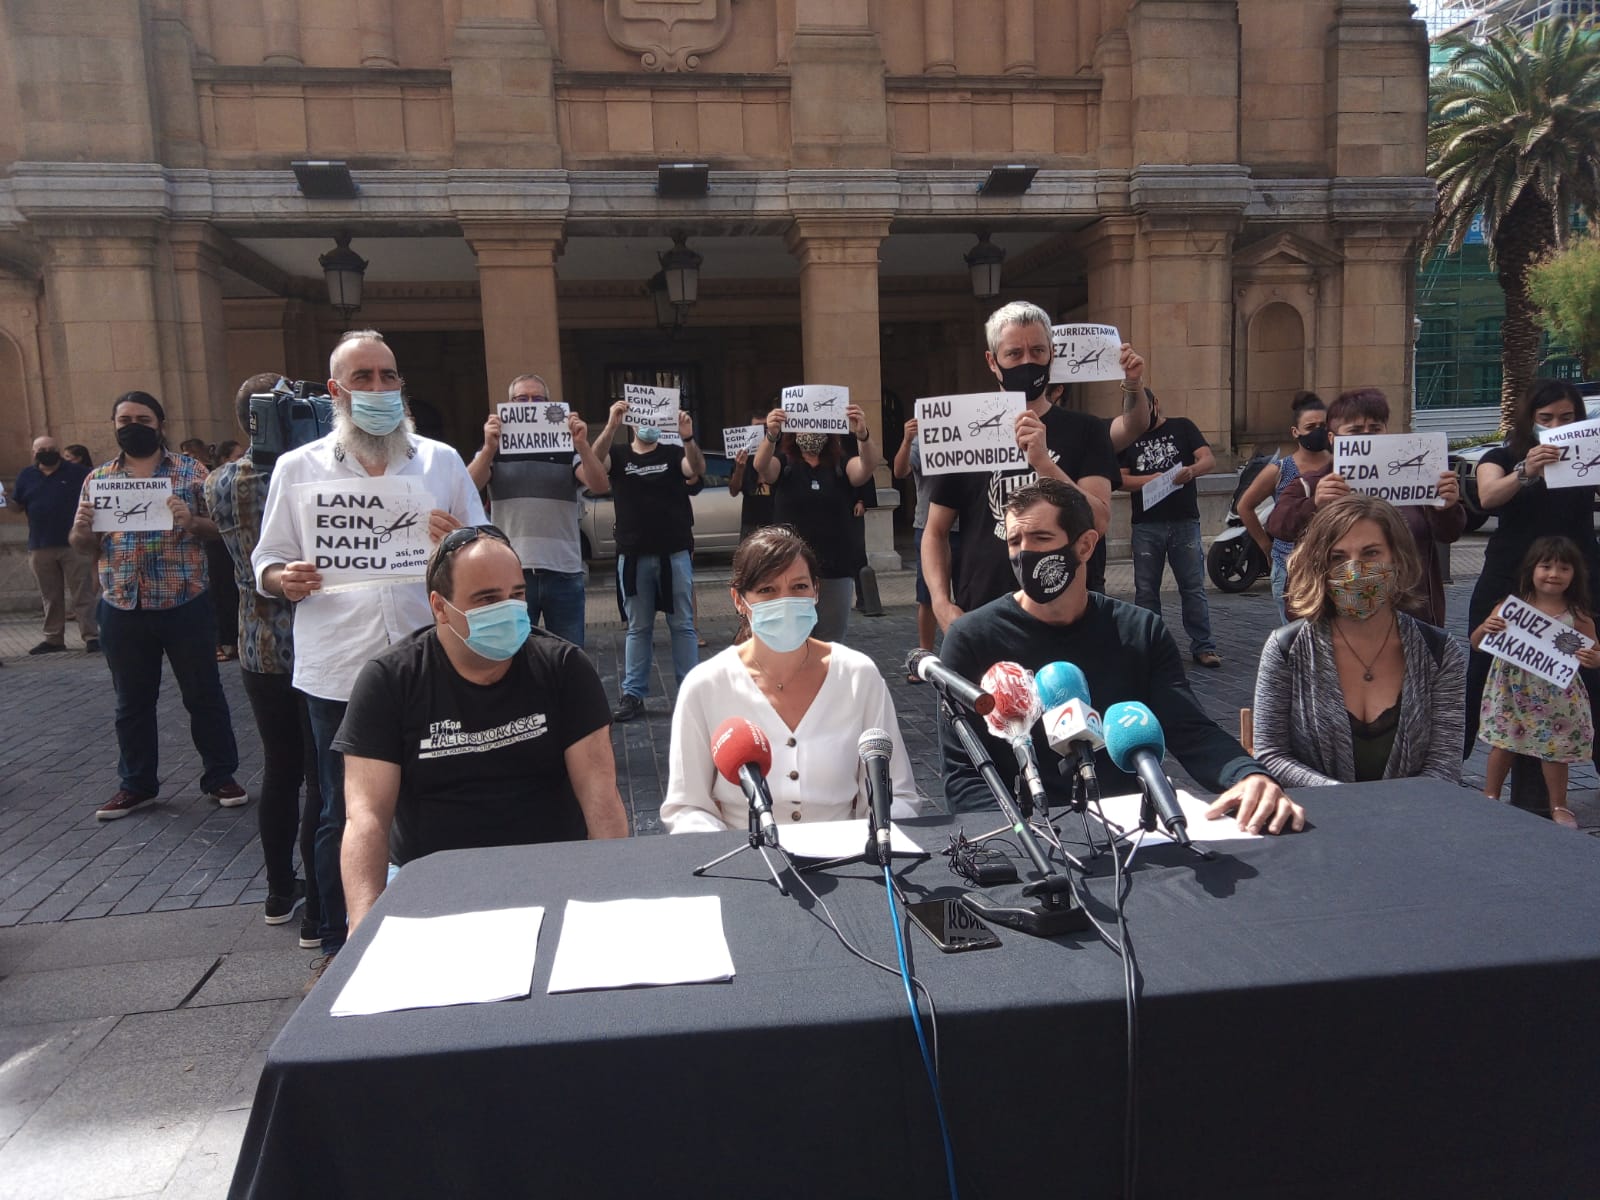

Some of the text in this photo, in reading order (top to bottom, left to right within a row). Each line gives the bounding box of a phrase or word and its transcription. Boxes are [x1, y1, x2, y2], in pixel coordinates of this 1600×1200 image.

[626, 386, 655, 395] LANA
[785, 389, 804, 398] HAU
[628, 396, 652, 405] EGIN
[797, 403, 809, 412] DA
[500, 406, 538, 424] GAUEZ
[922, 401, 951, 419] HAU
[625, 415, 656, 427] DUGU
[784, 418, 848, 430] KONPONBIDEA
[923, 426, 962, 444] EZ DA
[1339, 440, 1371, 456] HAU
[925, 447, 1026, 469] KONPONBIDEA
[1358, 464, 1379, 479] DA
[96, 481, 167, 490] MURRIZKETARIK
[317, 493, 384, 509] LANA
[316, 514, 373, 529] EGIN
[316, 535, 379, 550] NAHI
[315, 555, 386, 569] DUGU
[390, 559, 428, 570] podemo
[1502, 602, 1552, 639] GAUEZ
